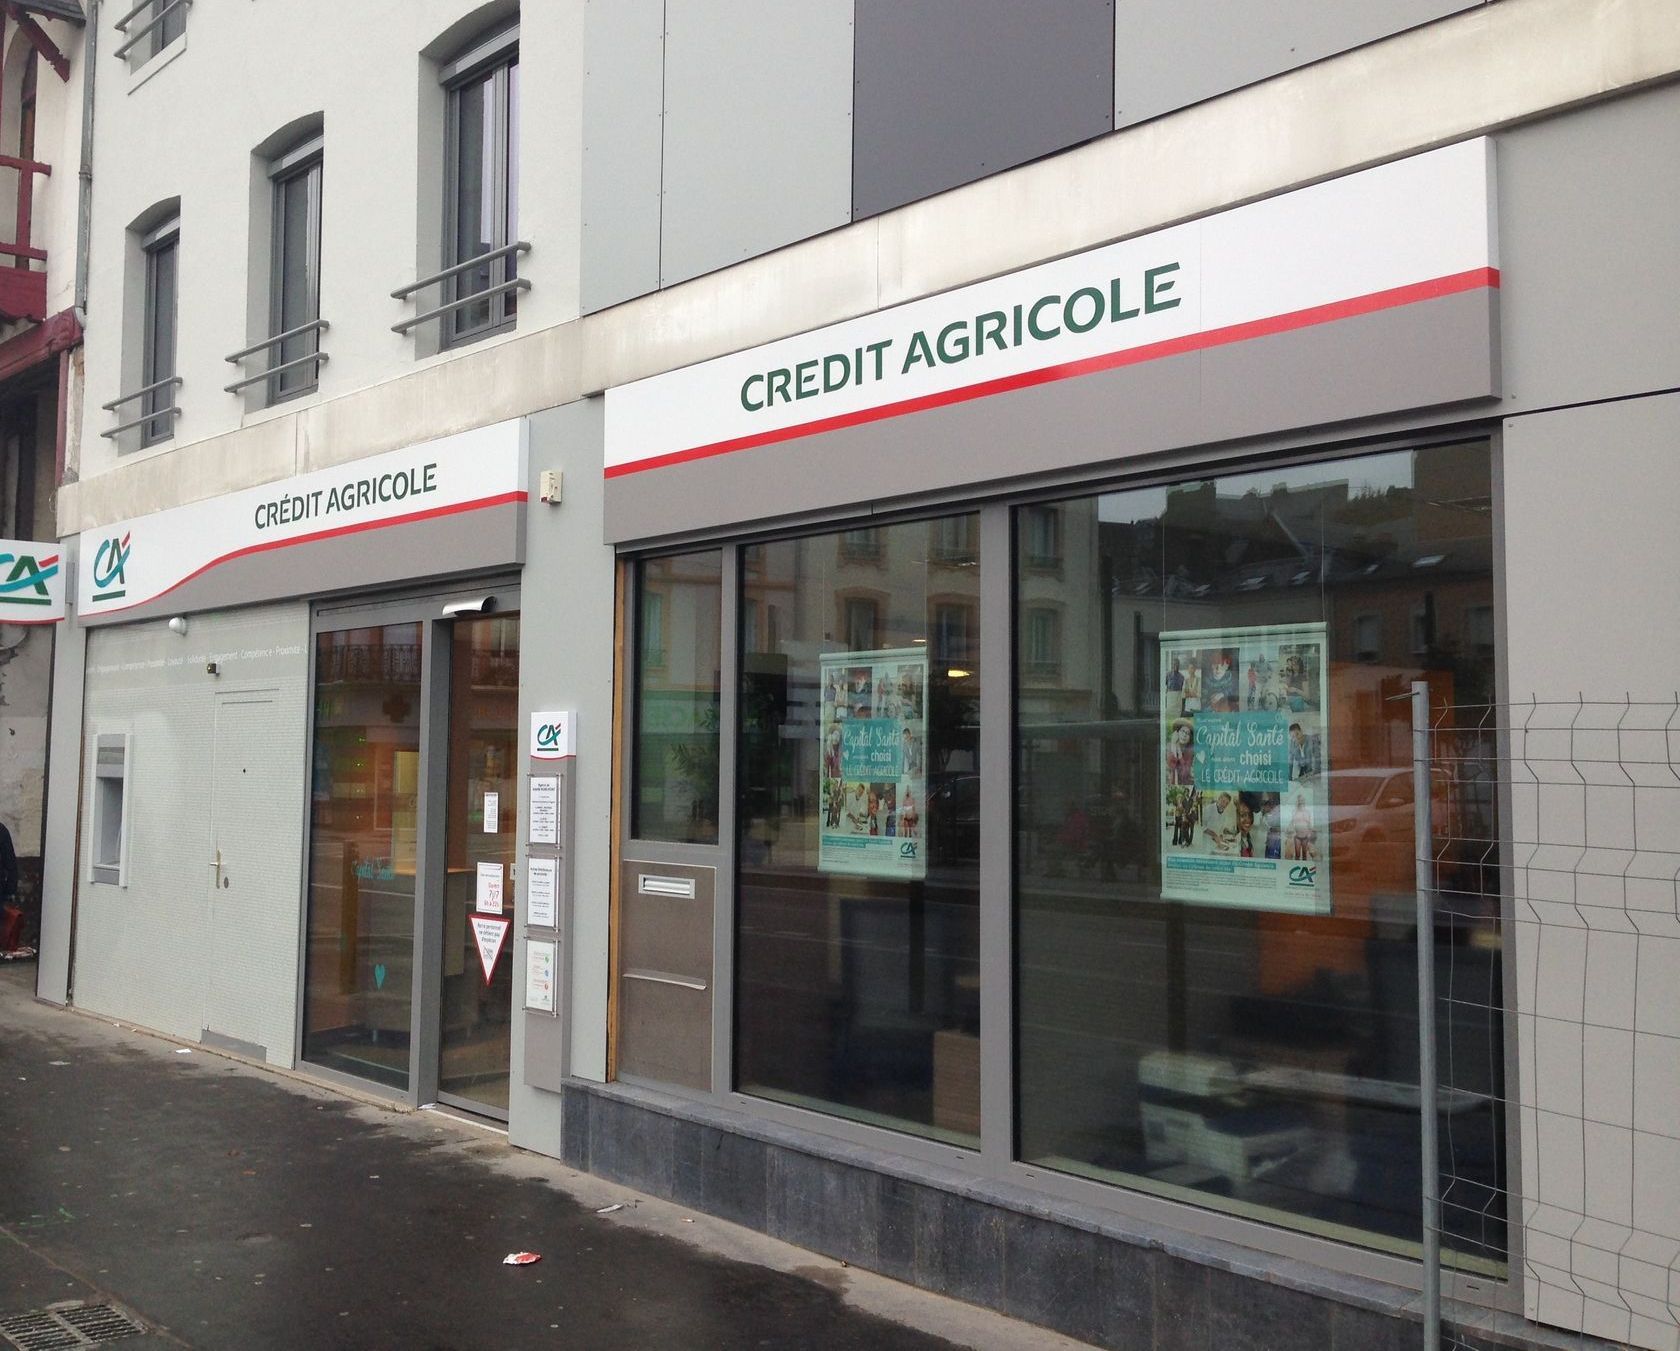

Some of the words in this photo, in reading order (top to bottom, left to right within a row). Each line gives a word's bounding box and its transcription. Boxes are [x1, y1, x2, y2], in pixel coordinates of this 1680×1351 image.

[740, 338, 893, 412] CREDIT
[901, 261, 1182, 375] AGRICOLE
[254, 493, 323, 530] CRÉDIT
[325, 463, 437, 515] AGRICOLE
[1196, 720, 1241, 754] Capital
[1246, 721, 1284, 747] Santé
[1201, 767, 1211, 783] LE
[1239, 750, 1272, 766] choisi
